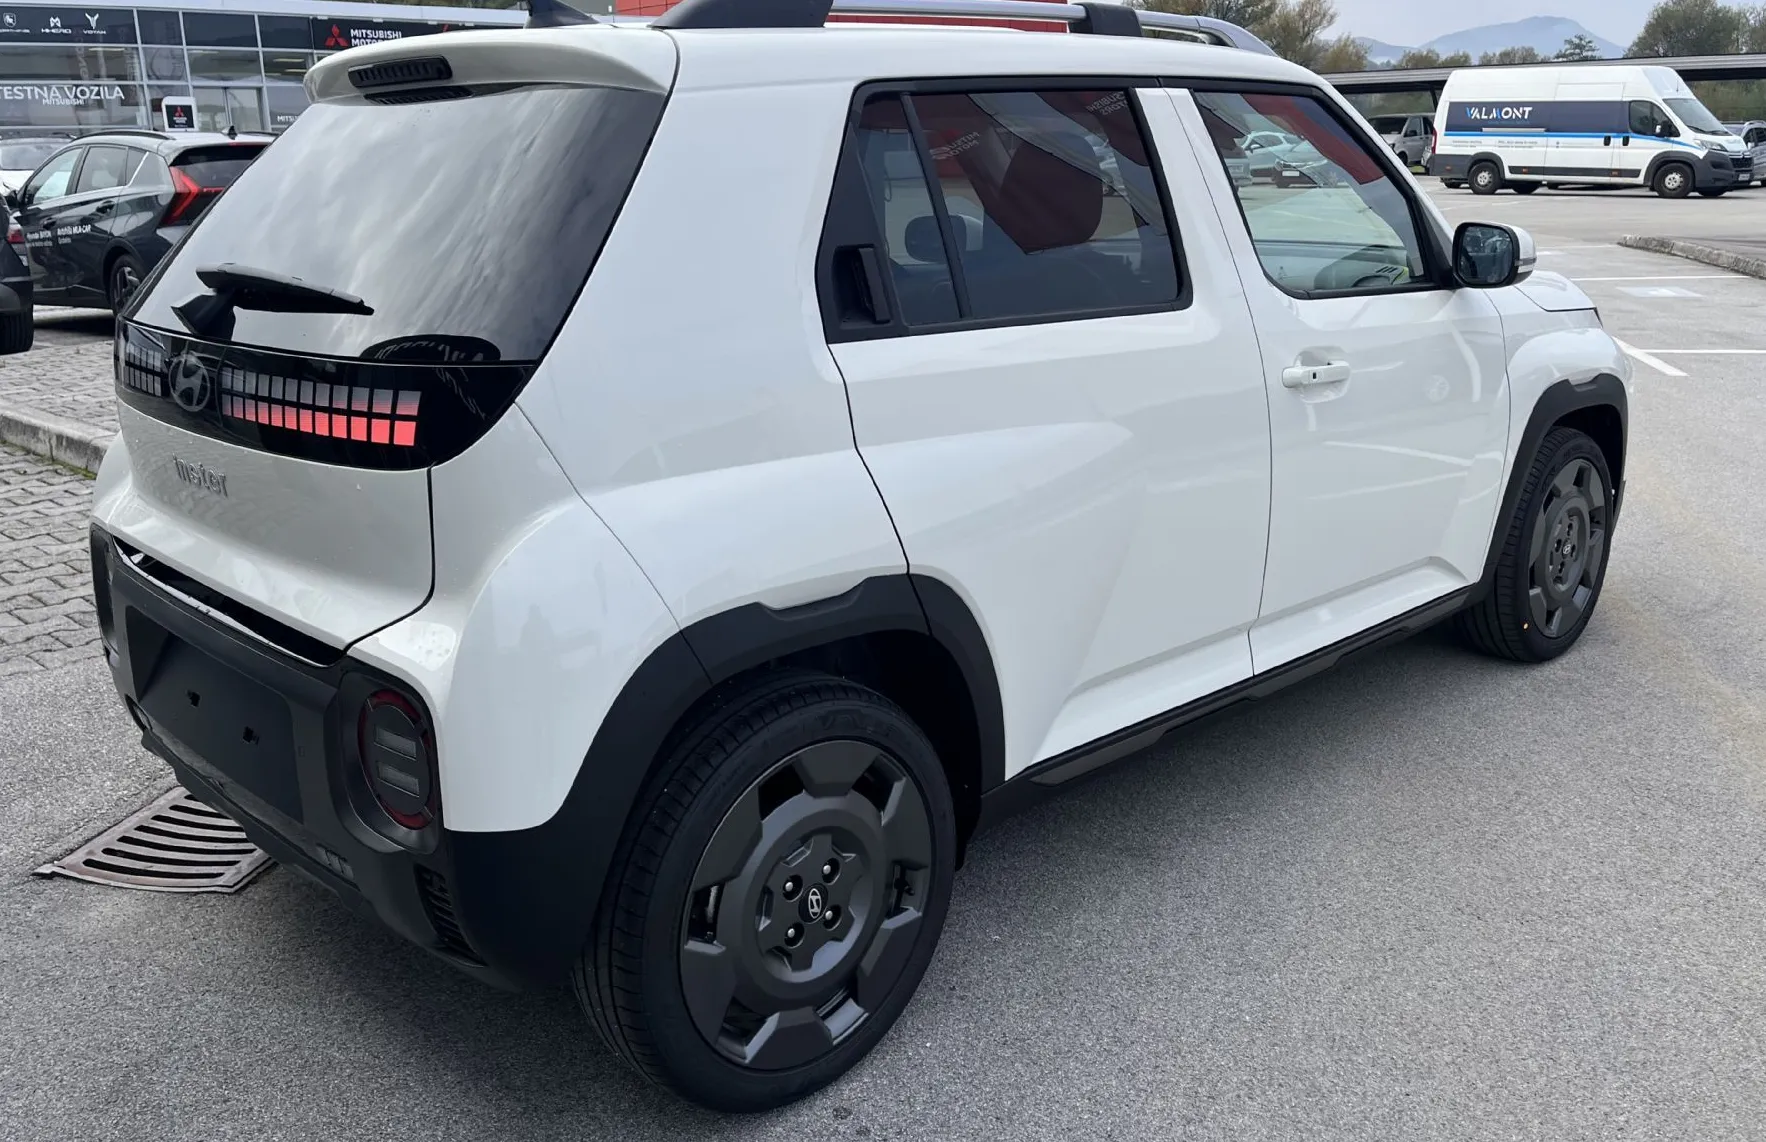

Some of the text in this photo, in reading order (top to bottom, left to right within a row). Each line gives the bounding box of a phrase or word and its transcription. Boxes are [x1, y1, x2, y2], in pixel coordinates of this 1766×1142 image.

[350, 28, 402, 39] MITSUBISHI
[63, 86, 125, 100] VOZILA
[42, 98, 84, 106] MITSUBISHI
[1466, 106, 1533, 119] VALMONT
